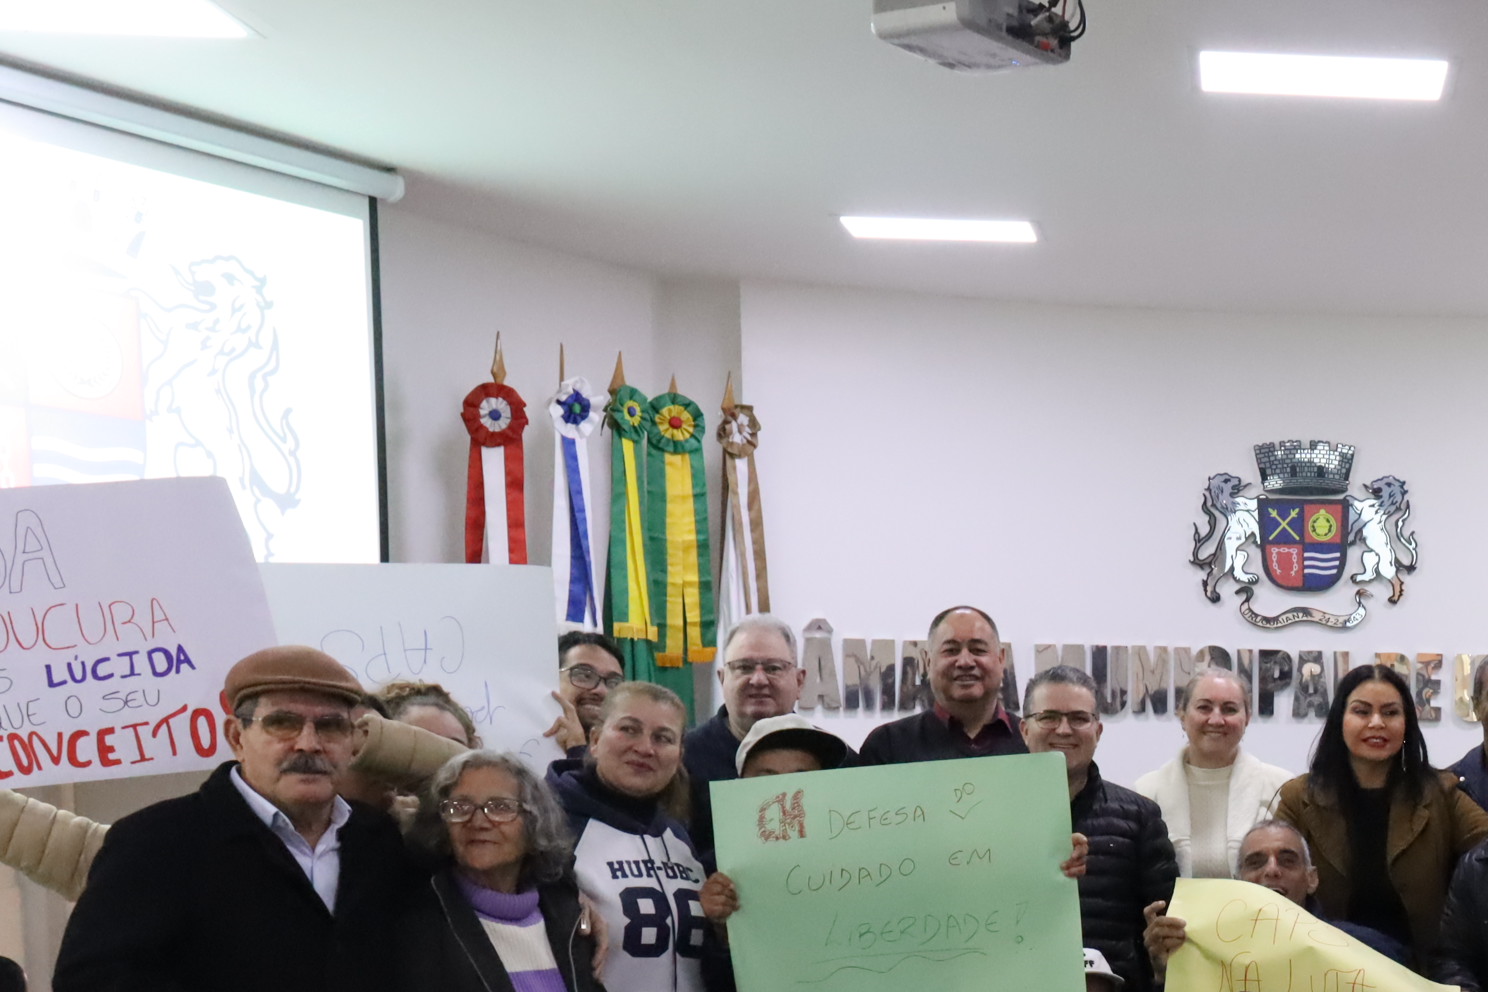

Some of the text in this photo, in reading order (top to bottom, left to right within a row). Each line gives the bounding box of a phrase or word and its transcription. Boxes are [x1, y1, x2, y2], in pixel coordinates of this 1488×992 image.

[44, 643, 197, 689] LÚCIDA
[64, 694, 83, 719] O
[98, 688, 161, 714] SEU
[828, 805, 926, 840] DEFESA
[785, 848, 992, 896] CUIDADO EM
[1216, 899, 1349, 947] CAPS
